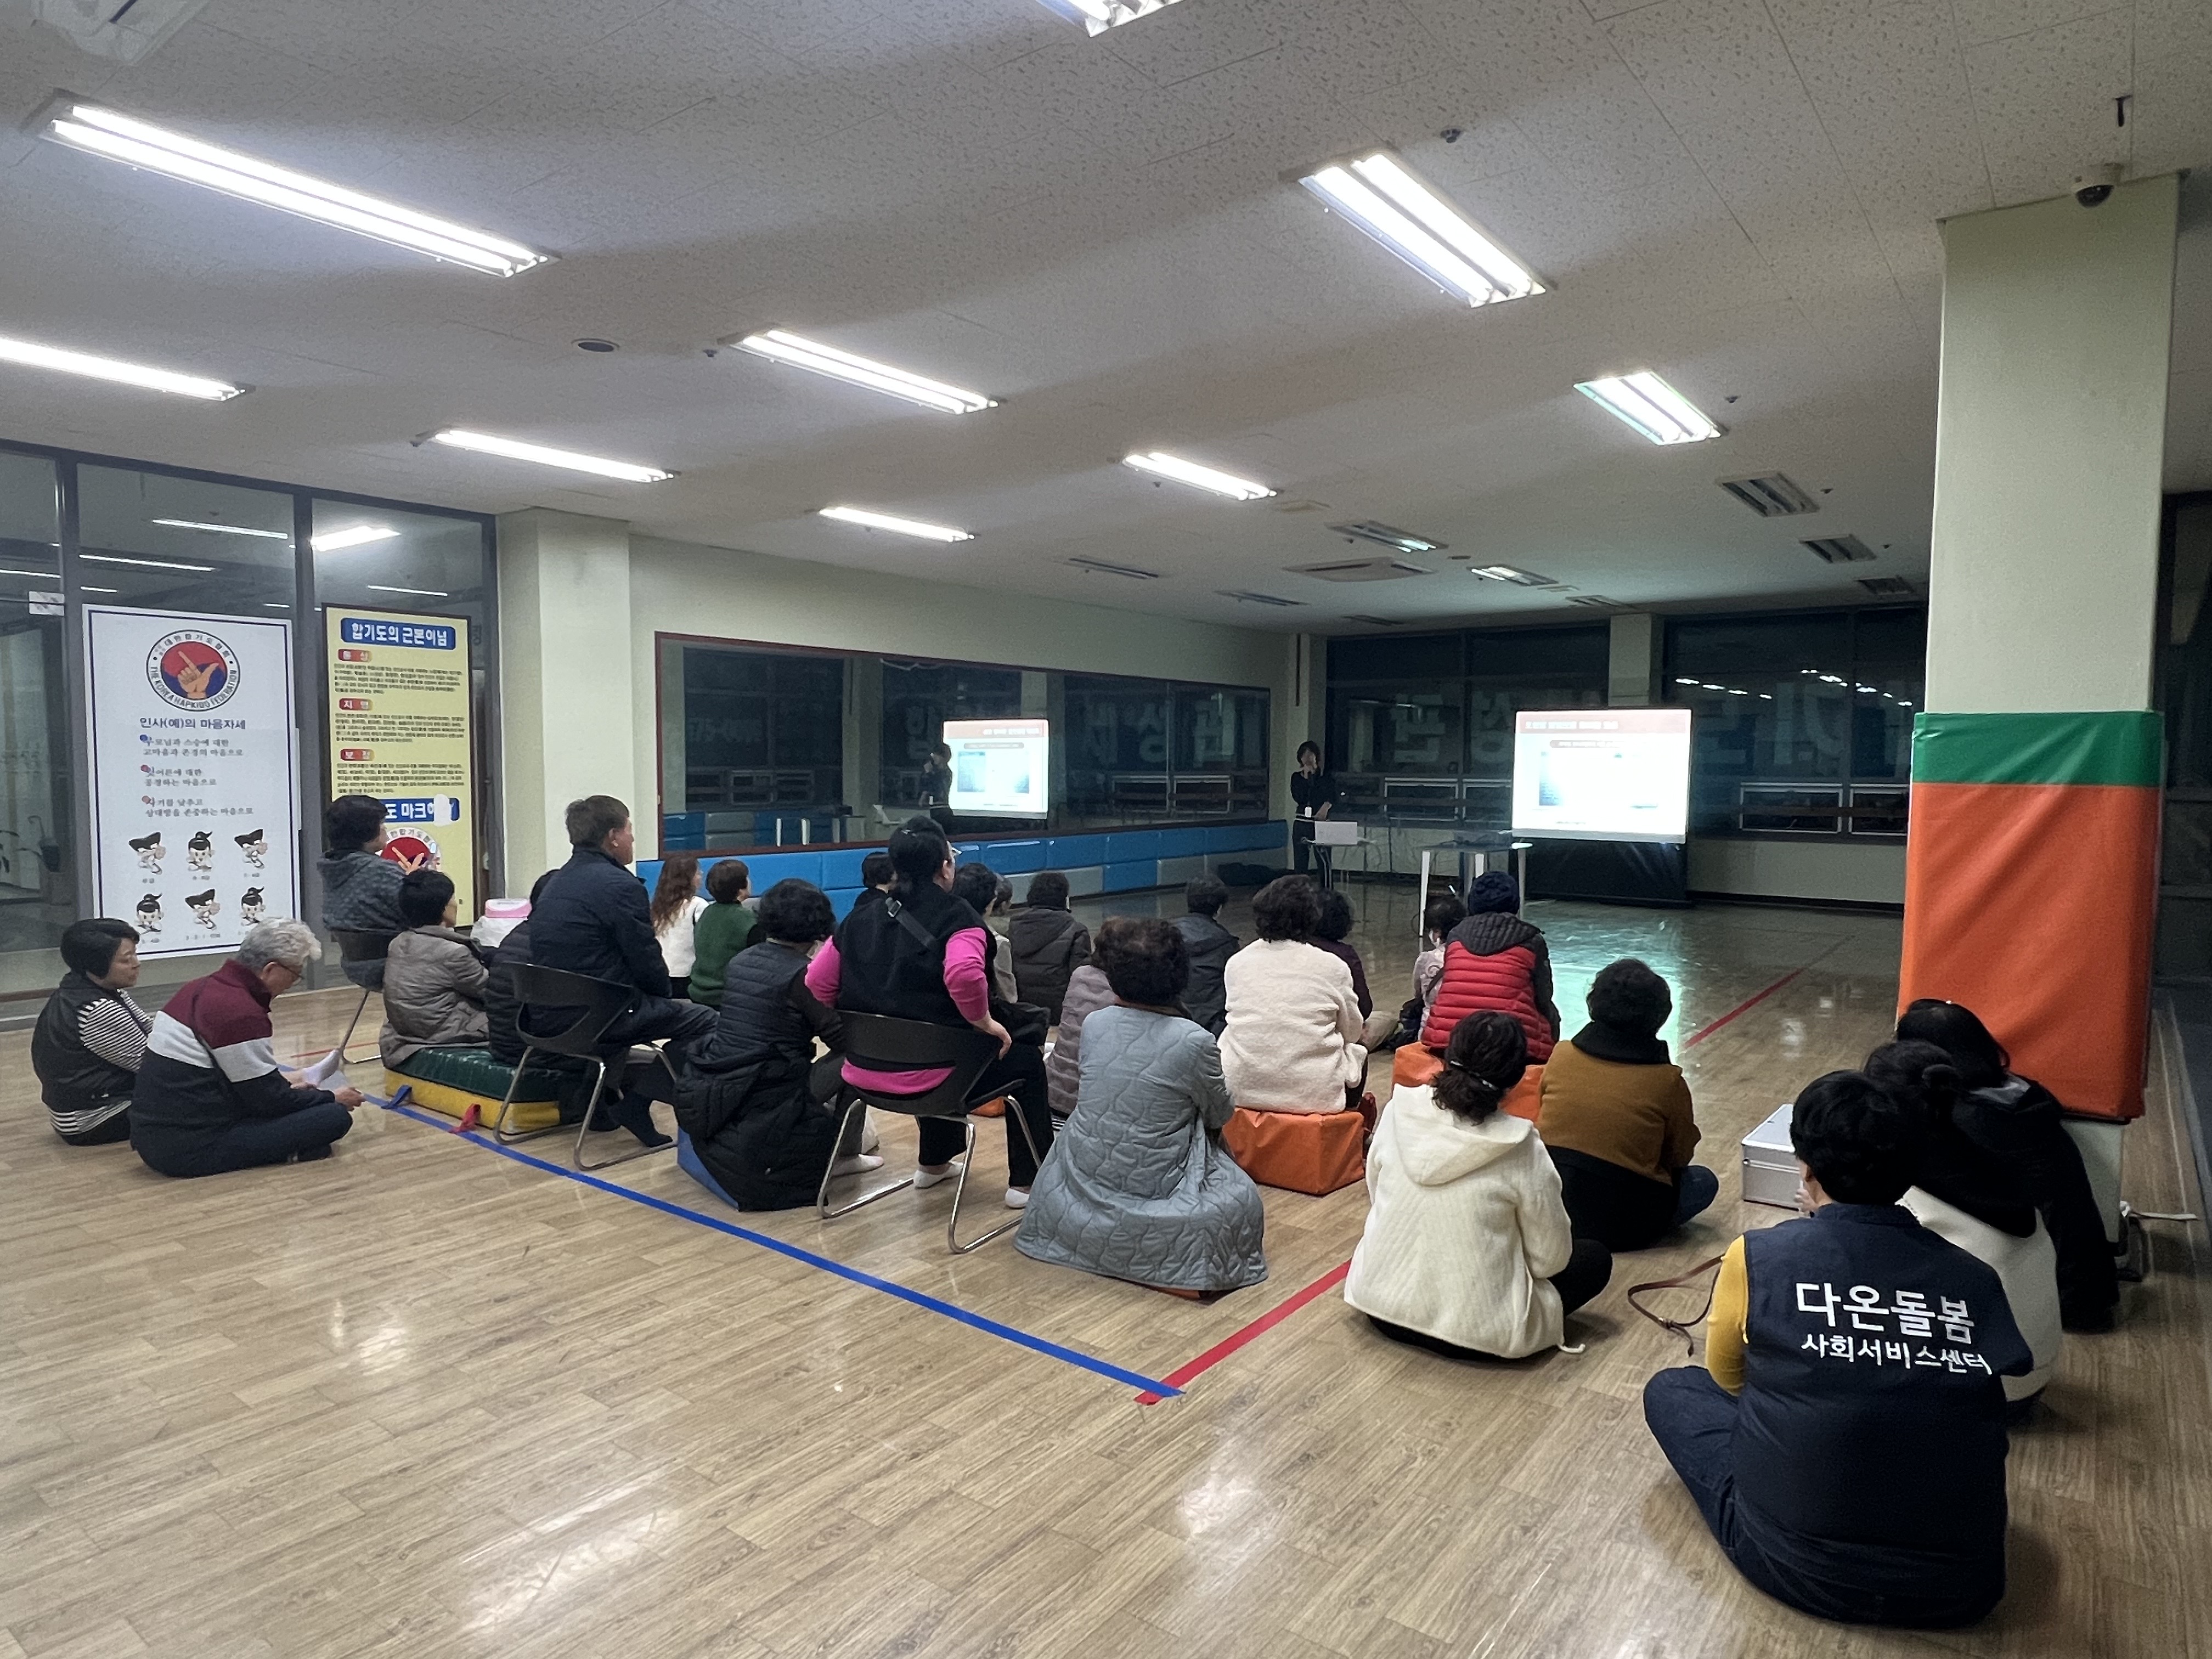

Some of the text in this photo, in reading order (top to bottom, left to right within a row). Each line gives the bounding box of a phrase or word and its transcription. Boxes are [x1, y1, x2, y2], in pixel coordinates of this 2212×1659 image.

[351, 622, 447, 647] 합기도의 근본이념
[139, 718, 246, 730] 인사(예)의 마음자세
[1796, 1283, 1975, 1344] 다온돌봄
[1801, 1333, 1993, 1375] 사회서비스센터
